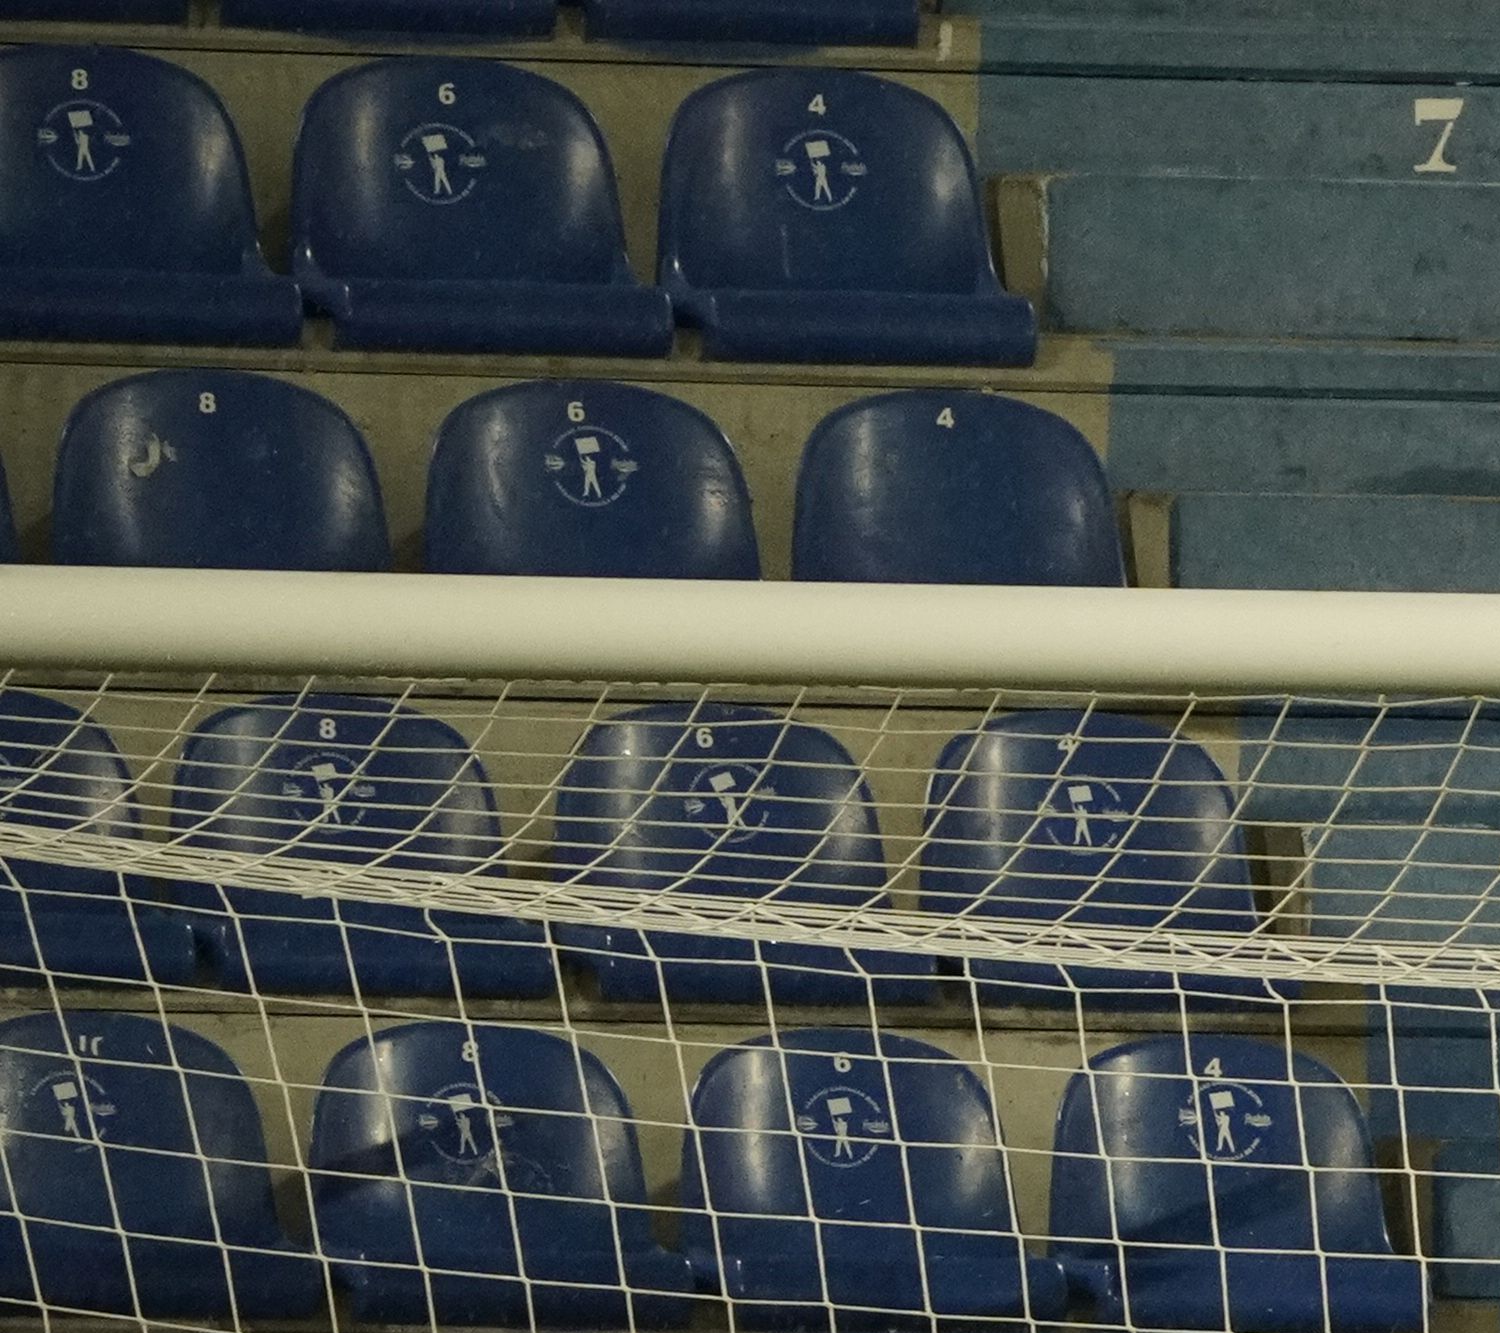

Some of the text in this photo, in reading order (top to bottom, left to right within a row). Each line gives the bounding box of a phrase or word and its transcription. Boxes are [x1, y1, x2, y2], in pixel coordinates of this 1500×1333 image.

[71, 68, 89, 90] 8
[438, 82, 456, 105] 6
[808, 94, 827, 115] 4
[1414, 97, 1464, 172] 7
[199, 391, 217, 414] 8
[567, 401, 585, 423] 6
[936, 407, 955, 429] 4
[319, 718, 337, 739] 8
[696, 728, 714, 749] 6
[834, 1051, 852, 1073] 6
[1204, 1058, 1223, 1078] 4
